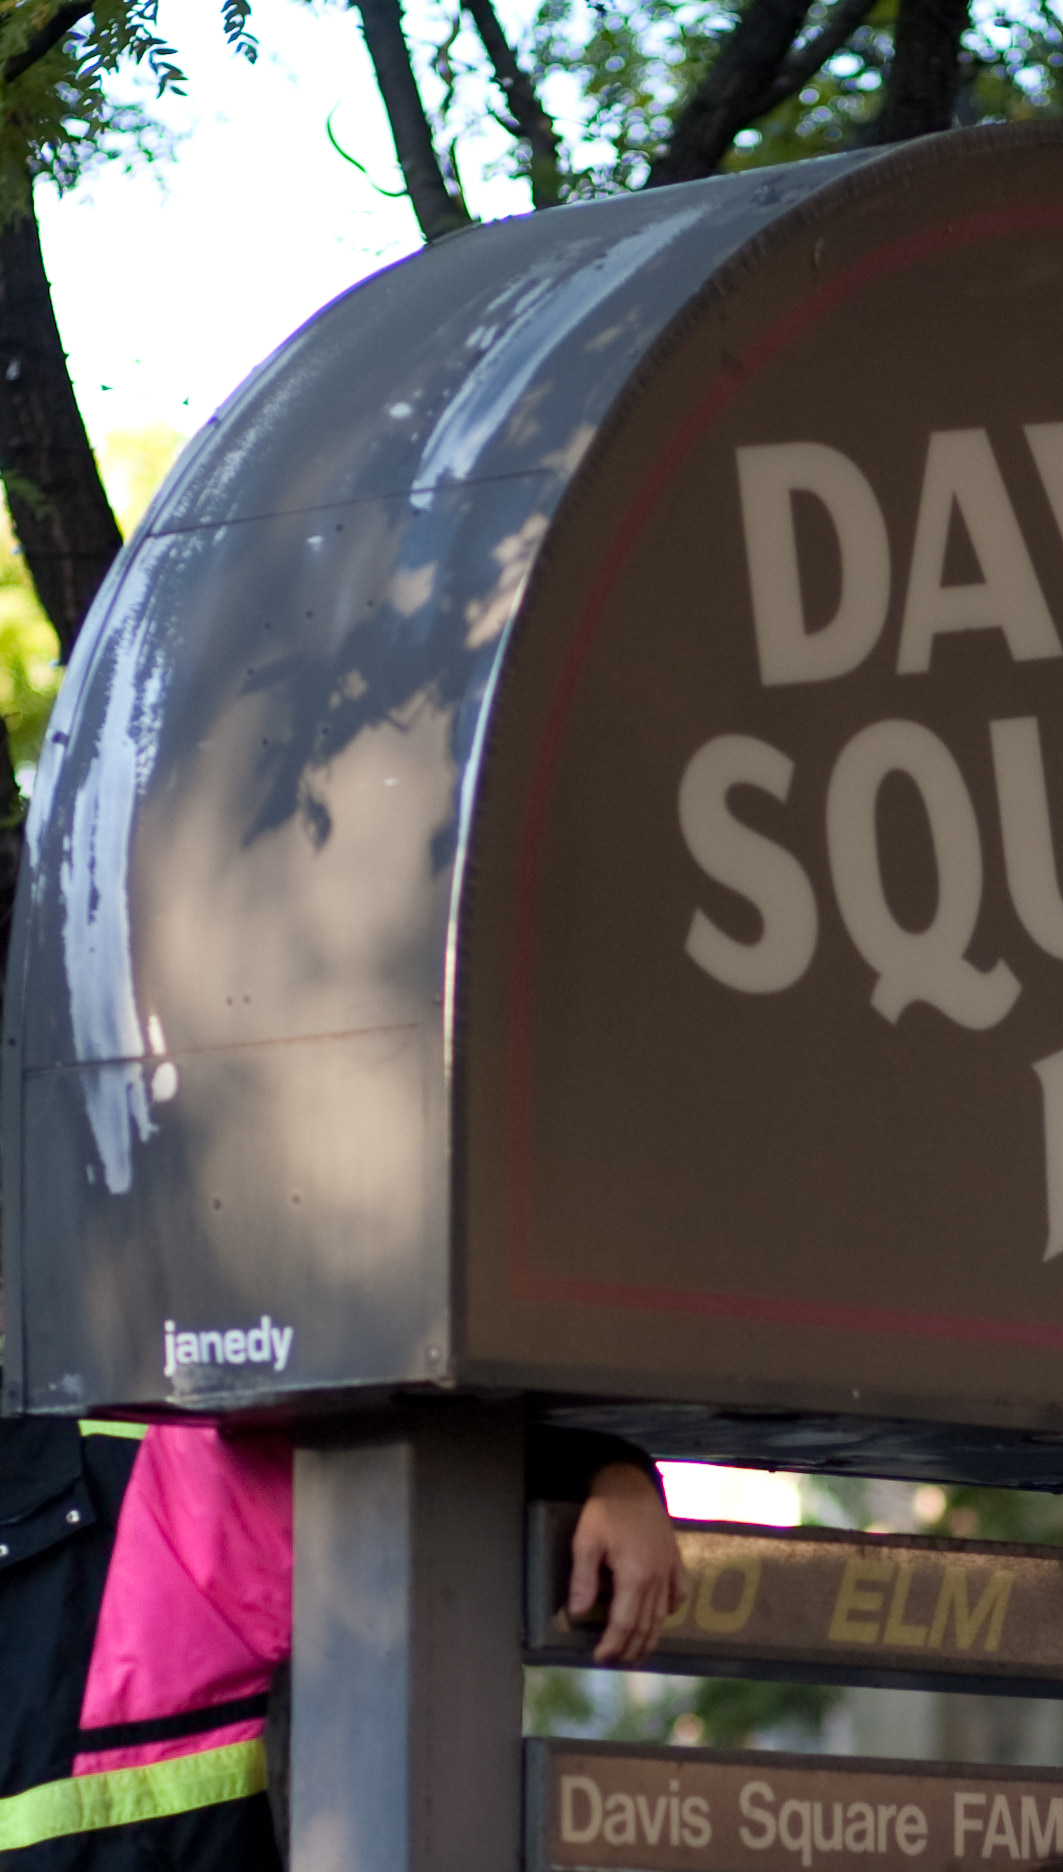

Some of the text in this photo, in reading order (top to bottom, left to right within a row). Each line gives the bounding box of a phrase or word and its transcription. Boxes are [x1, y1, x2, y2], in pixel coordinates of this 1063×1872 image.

[164, 1315, 293, 1377] janedy
[827, 1558, 1015, 1653] ELM
[560, 1775, 712, 1848] Davis
[738, 1780, 929, 1867] Square
